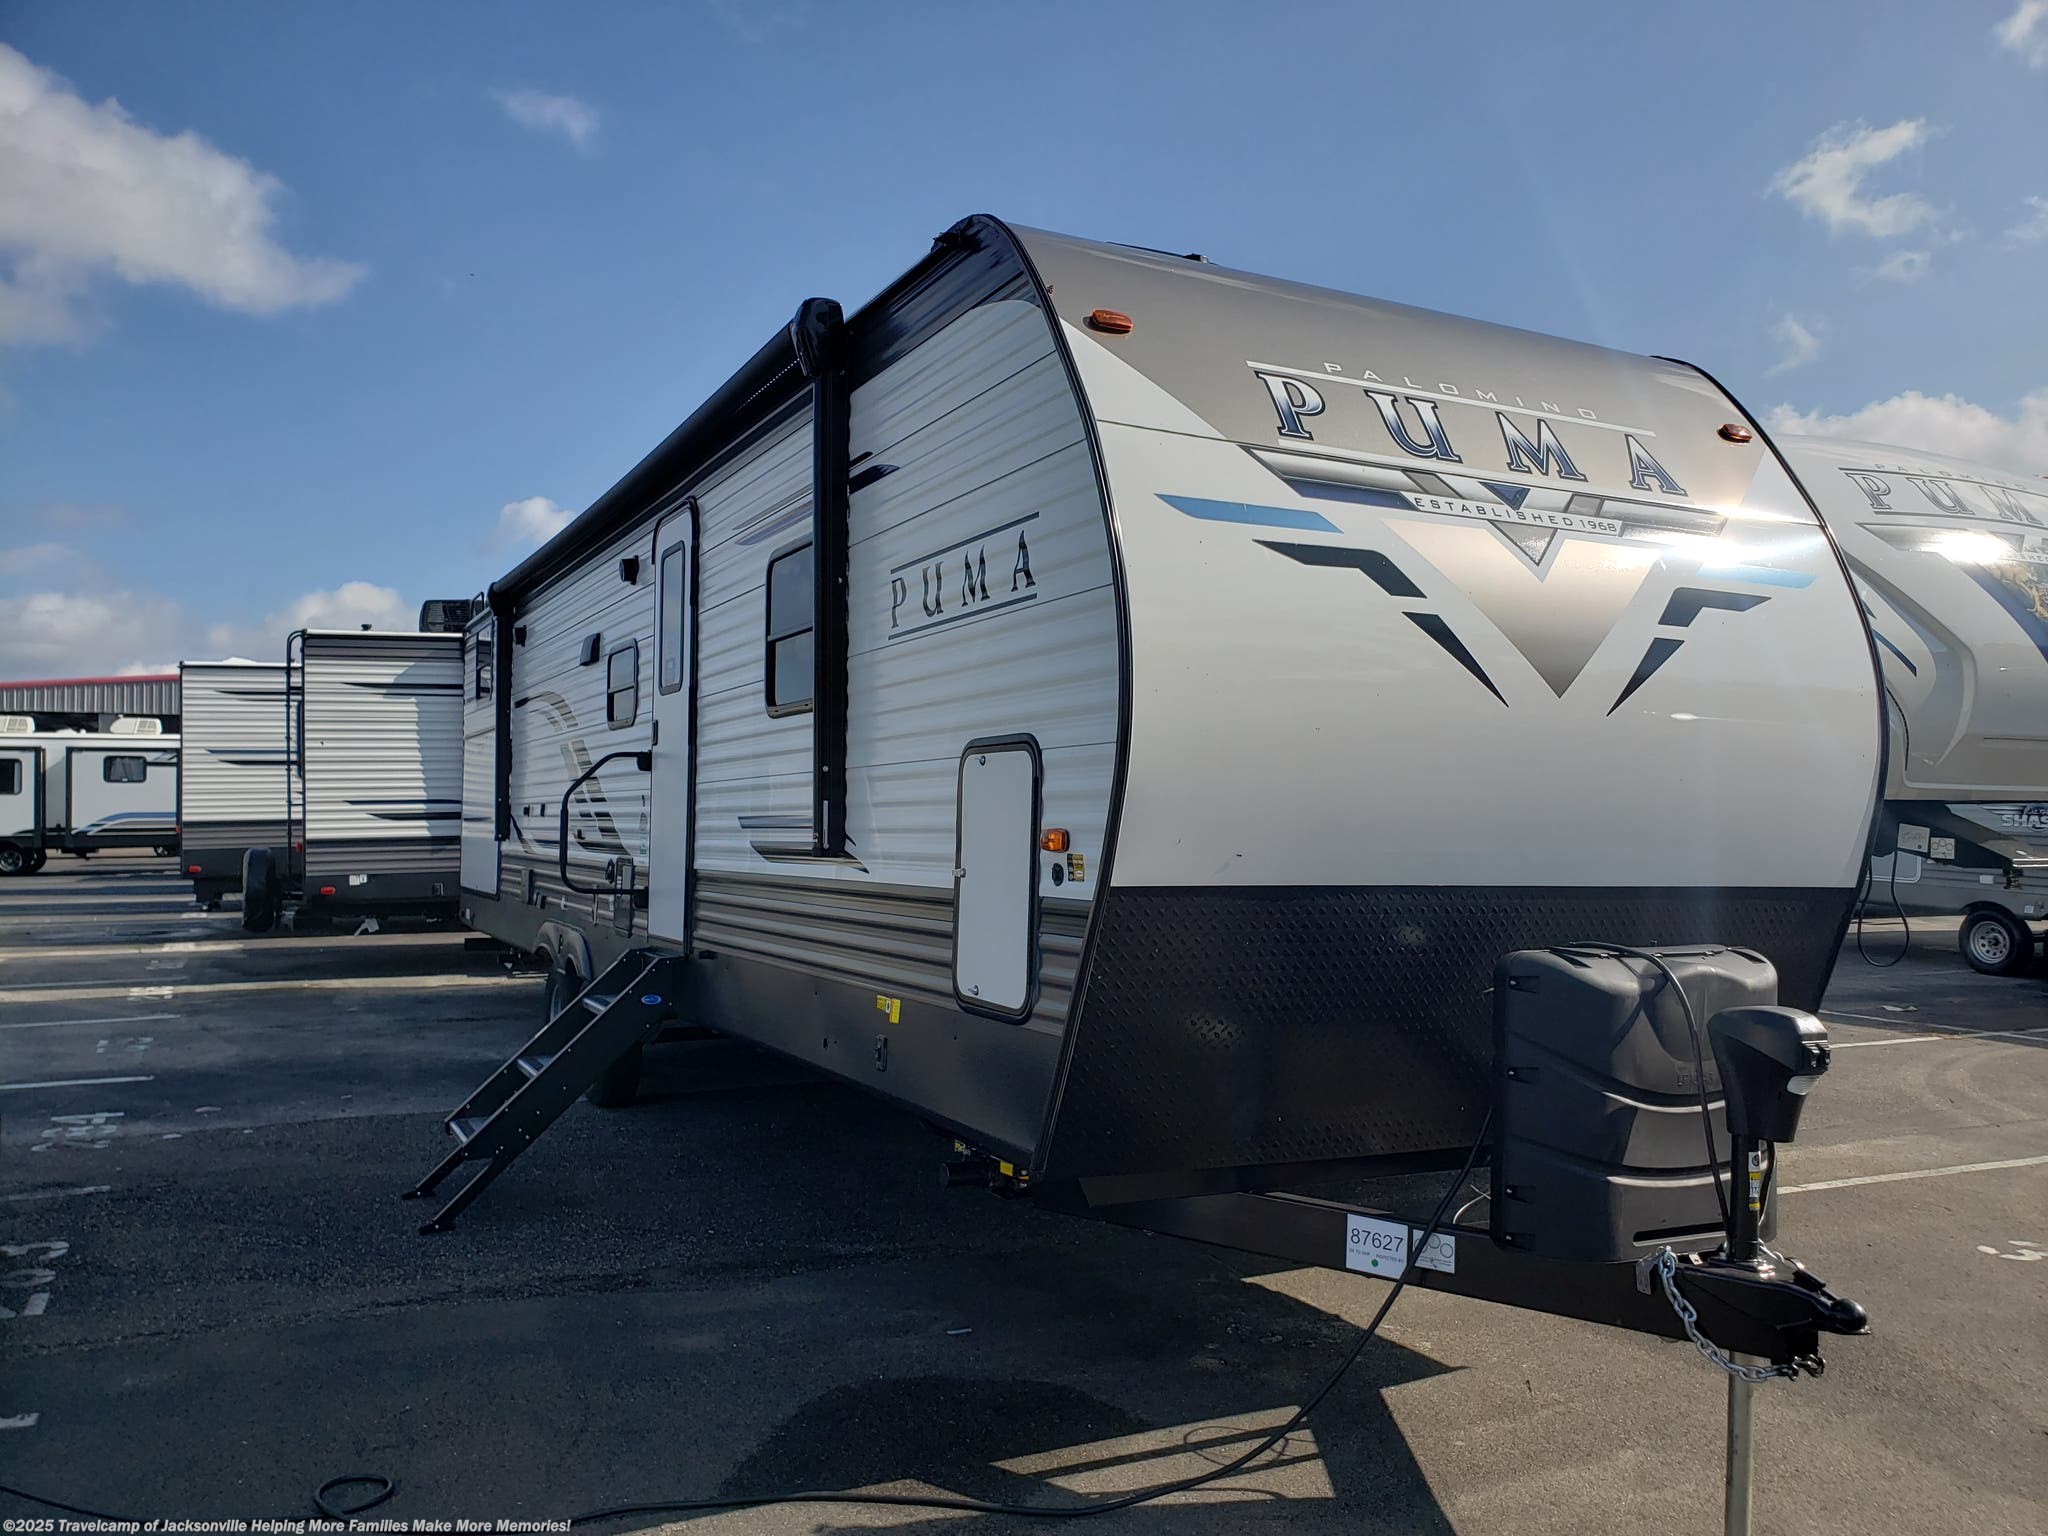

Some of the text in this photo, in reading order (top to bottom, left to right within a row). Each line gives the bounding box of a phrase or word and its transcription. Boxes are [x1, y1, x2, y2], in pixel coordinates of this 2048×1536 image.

[1323, 361, 1597, 419] PALOMINO
[1254, 369, 1688, 497] PUMA
[1413, 496, 1618, 532] ESTABLISHED 1968
[890, 529, 1037, 630] PUMA
[1350, 1227, 1404, 1253] 87627
